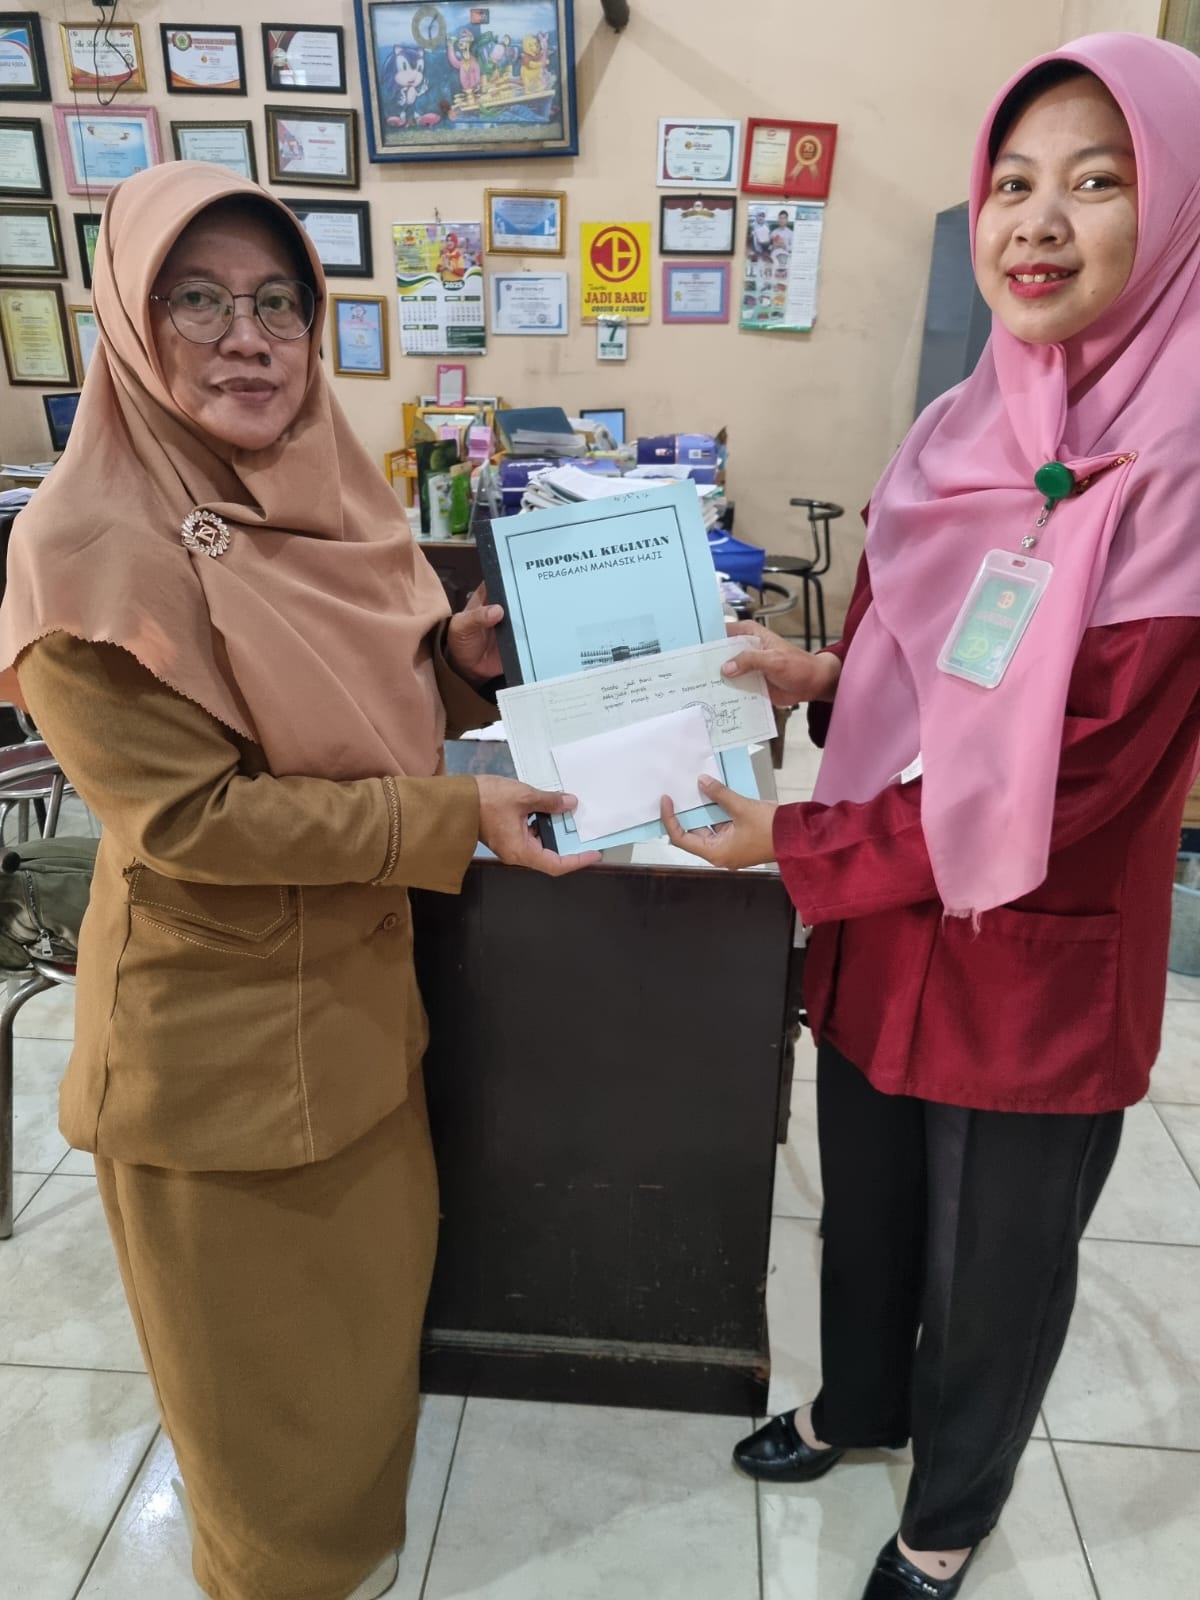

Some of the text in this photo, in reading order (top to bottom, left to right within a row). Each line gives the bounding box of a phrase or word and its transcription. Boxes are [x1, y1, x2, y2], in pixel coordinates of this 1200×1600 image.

[584, 291, 648, 304] JADI BARU
[606, 321, 619, 342] 7
[525, 536, 669, 570] PROPOSAL KEGIATAN
[537, 550, 664, 581] PERAGAAN MANASIK HAJI
